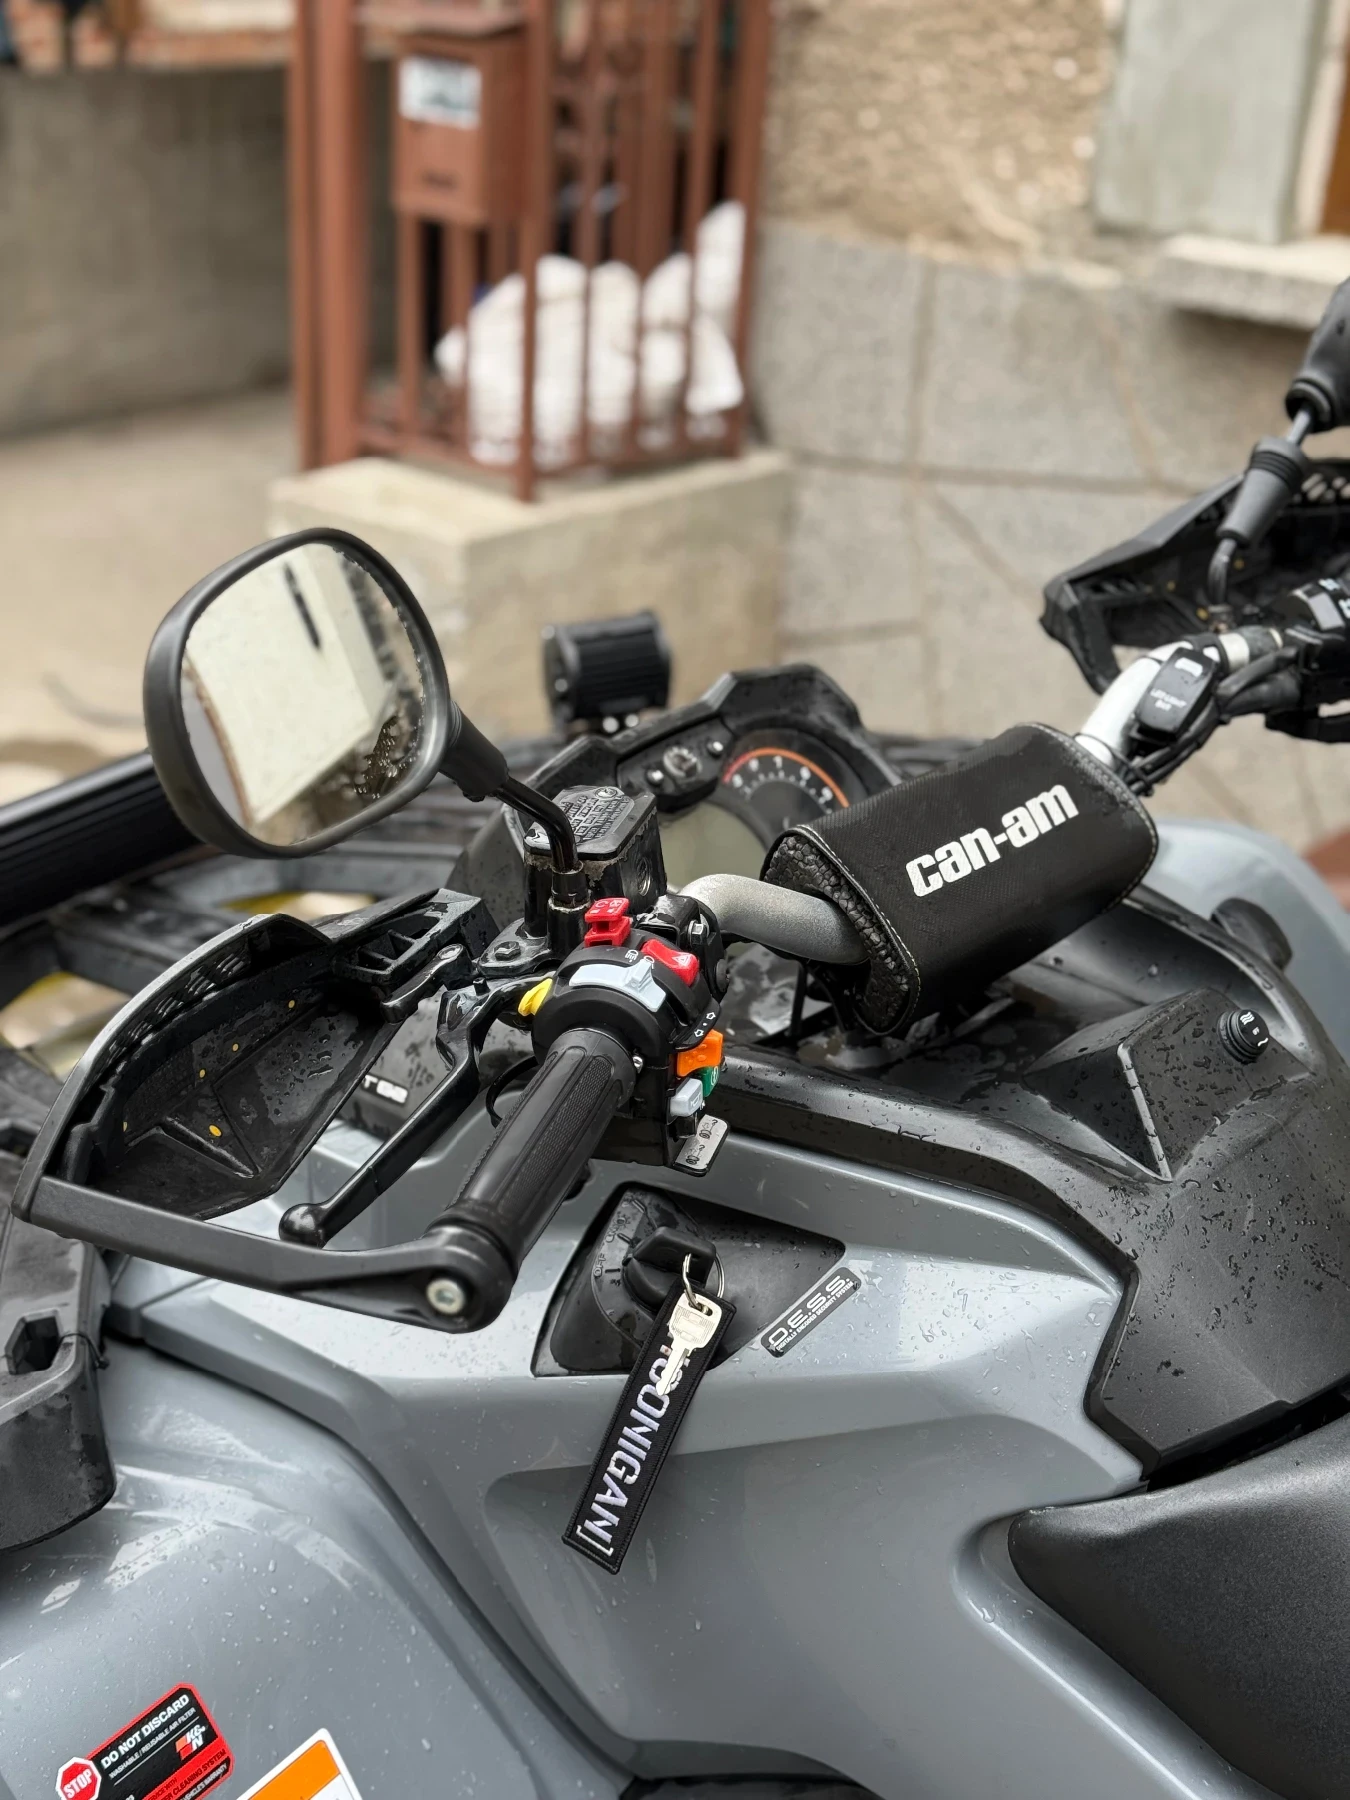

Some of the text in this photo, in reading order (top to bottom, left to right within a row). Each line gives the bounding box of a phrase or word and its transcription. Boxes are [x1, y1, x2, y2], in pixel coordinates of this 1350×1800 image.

[906, 785, 1080, 897] can-am
[593, 1253, 606, 1277] OFF
[769, 1275, 850, 1346] D.E.S.S.
[776, 1281, 854, 1351] DIGITALLY ENCODED SECURITY SYSTEM
[101, 1694, 189, 1769] DO NOT DISCARD
[108, 1751, 140, 1779] WASHABLE
[141, 1728, 169, 1753] REUSABLE
[169, 1720, 180, 1732] AIR
[178, 1707, 196, 1724] FILTER
[63, 1768, 93, 1799] STOP
[164, 1777, 178, 1791] WITH
[172, 1749, 227, 1795] CLEANING SYSTEM
